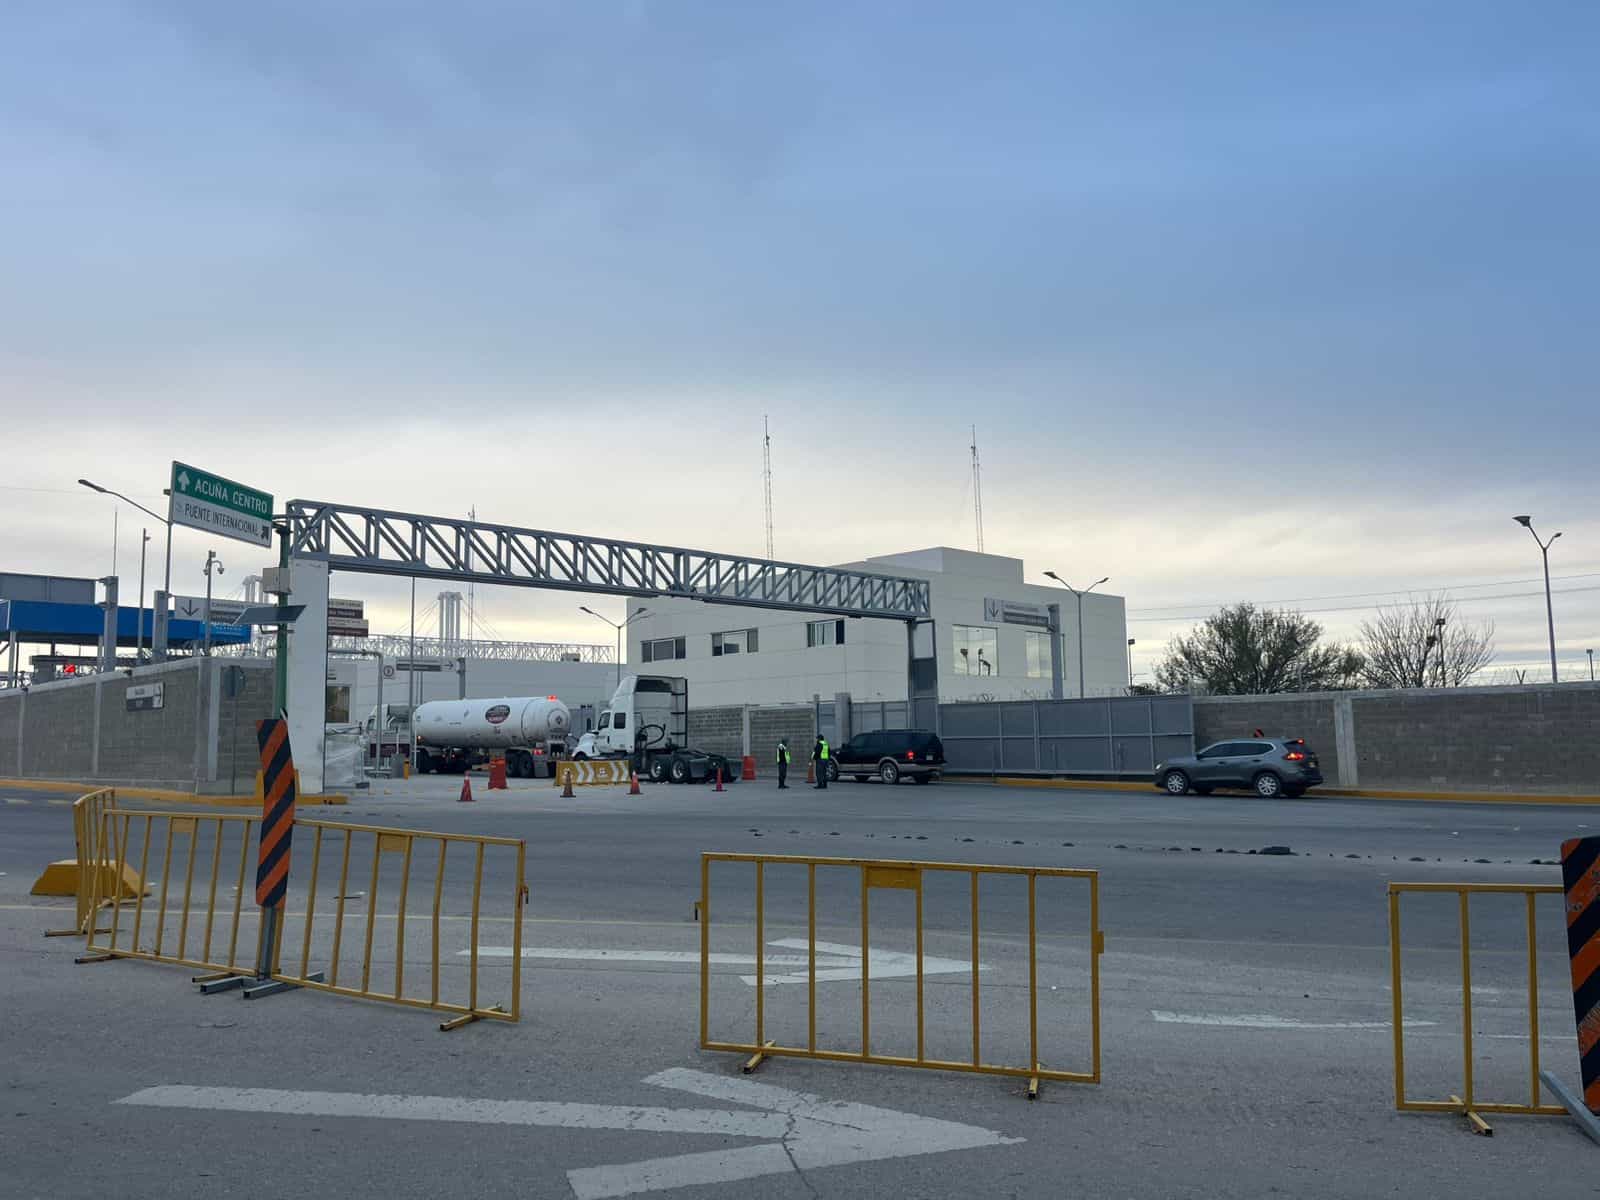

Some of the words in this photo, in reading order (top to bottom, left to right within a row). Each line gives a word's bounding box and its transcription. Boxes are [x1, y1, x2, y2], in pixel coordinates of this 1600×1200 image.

[194, 478, 228, 502] ACUÑA
[232, 491, 268, 513] CENTRO
[184, 503, 211, 523] PUENTE
[213, 511, 259, 536] INTERNACIONAL
